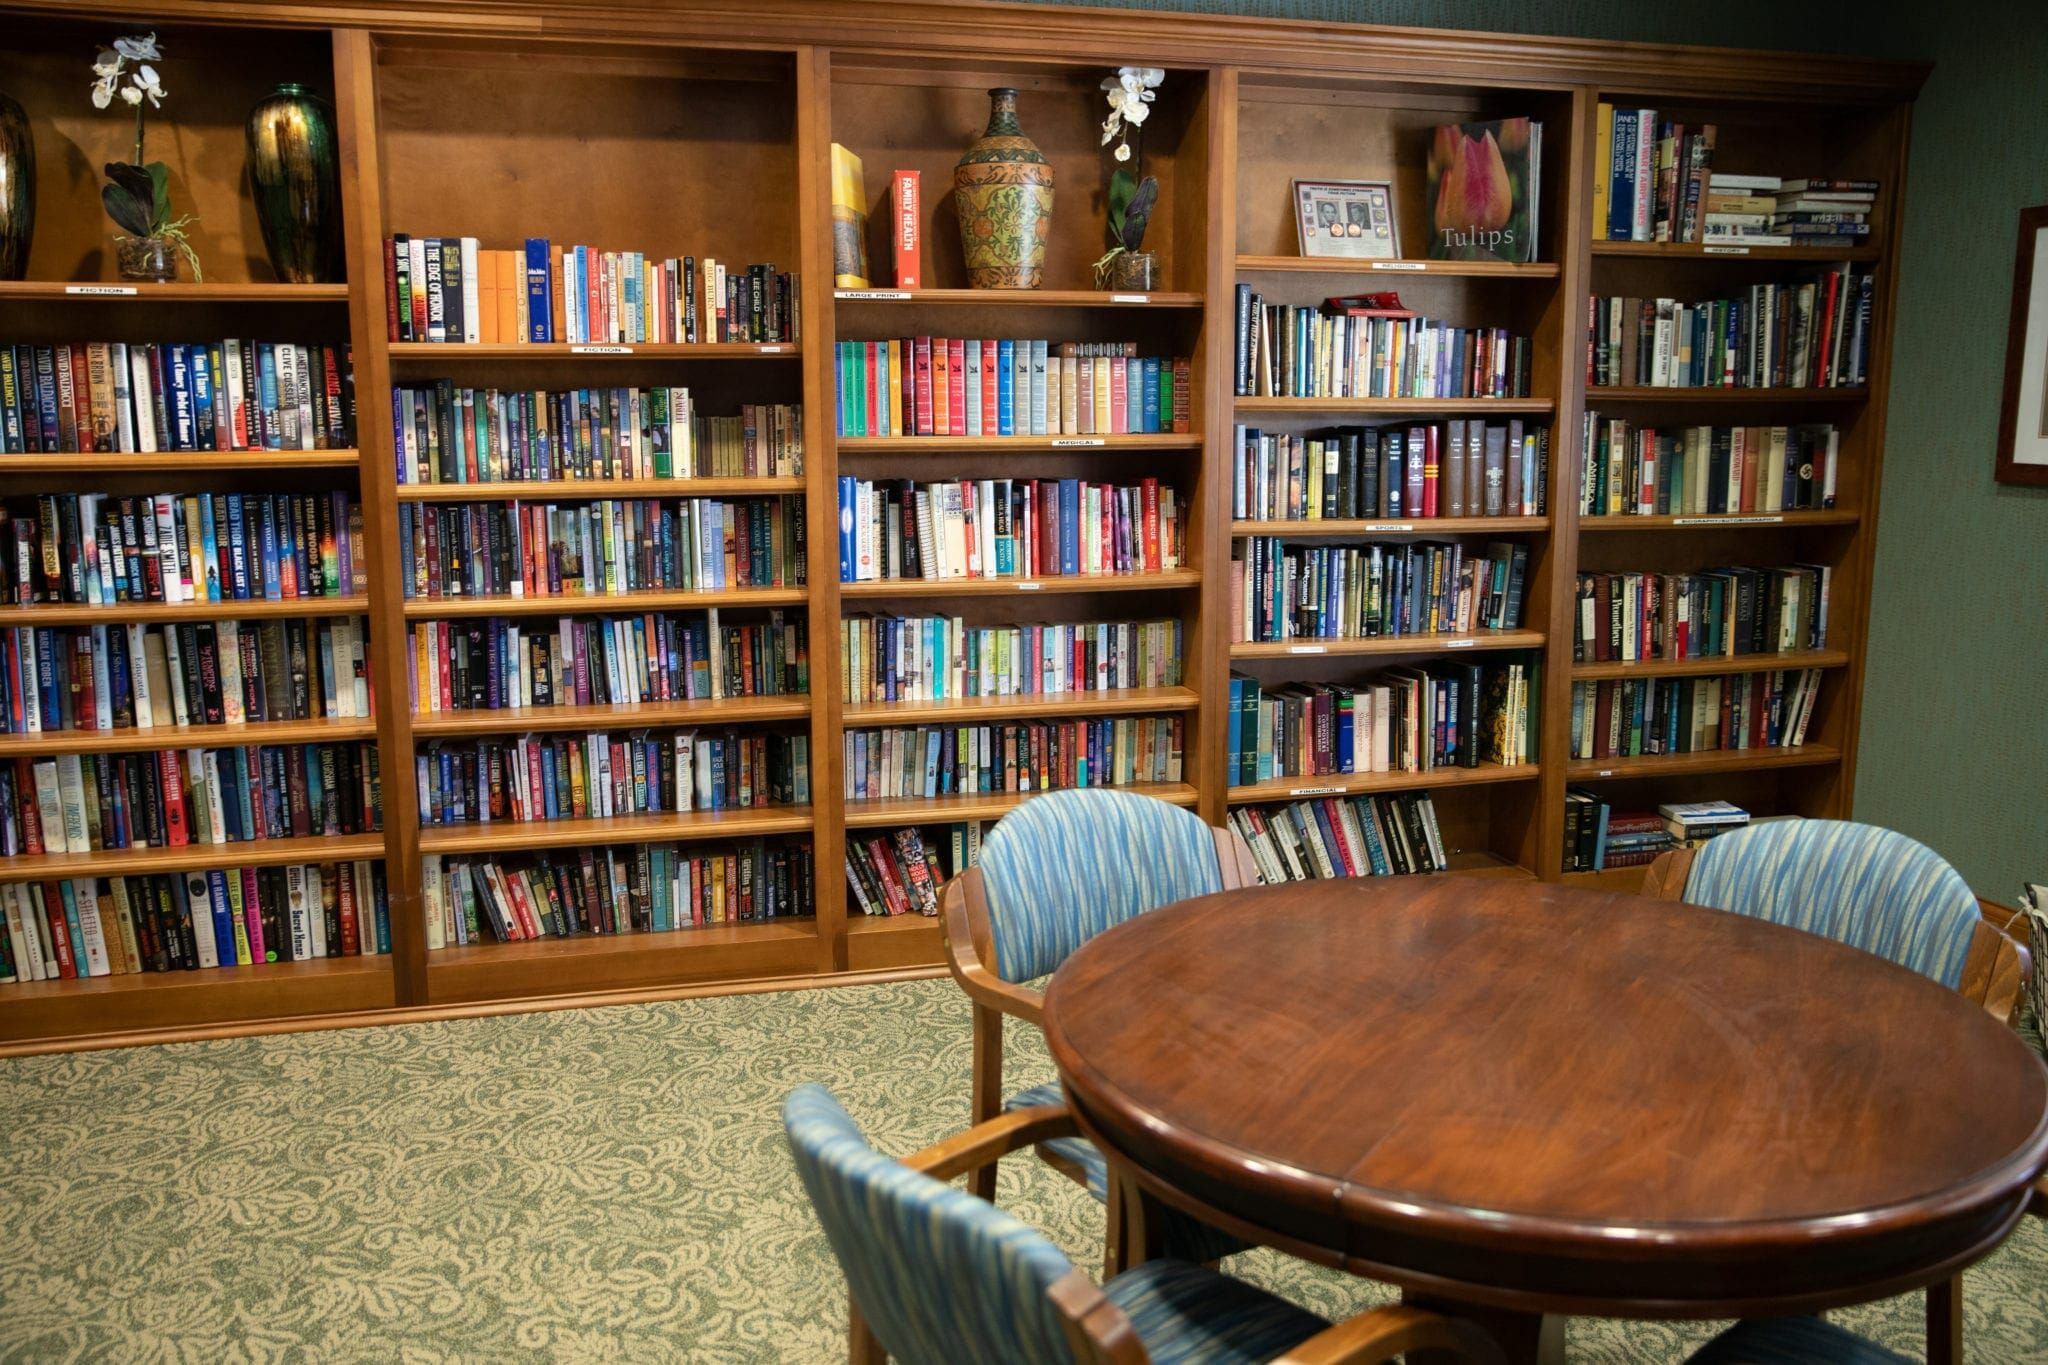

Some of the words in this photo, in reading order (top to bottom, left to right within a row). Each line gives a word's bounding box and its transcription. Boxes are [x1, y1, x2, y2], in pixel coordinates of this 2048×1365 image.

[1642, 113, 1650, 144] WORLD
[1640, 146, 1649, 167] WAR
[903, 178, 912, 210] FAMILY
[1638, 176, 1646, 226] AIRPLANES
[904, 214, 912, 250] HEALTH
[1441, 224, 1514, 250] Tulips
[428, 249, 438, 261] THE
[428, 264, 440, 280] EDGE
[415, 295, 425, 312] CATCH
[430, 293, 442, 321] HONOR
[1, 351, 10, 371] DAVID
[38, 350, 51, 372] DAVID
[58, 349, 68, 368] DAVID
[90, 346, 102, 358] DAN
[173, 346, 184, 360] Tom
[195, 354, 206, 370] Tom
[281, 348, 292, 370] CLIVE
[297, 352, 308, 370] JANET
[92, 361, 105, 384] BROWN
[174, 362, 188, 387] Clancy
[327, 372, 340, 394] KING
[3, 372, 12, 406] BALDACCI
[41, 374, 55, 413] BALDACCI
[60, 369, 72, 407] BALDACCI
[196, 372, 208, 399] Clancy
[284, 373, 295, 406] CUSSLER
[299, 372, 309, 404] EVANOVICH
[244, 398, 252, 435] CRICHTON
[272, 410, 280, 434] SHELTER
[329, 396, 342, 430] REVIVAL
[1732, 446, 1741, 480] WOODWARD
[1588, 461, 1597, 503] AMERICA
[157, 504, 170, 514] NW
[214, 497, 224, 520] BRAD
[229, 496, 240, 520] BRAD
[903, 490, 912, 507] BAD
[263, 502, 272, 527] STUART
[276, 499, 286, 523] STUART
[294, 500, 303, 528] STUART
[305, 498, 317, 530] STUART
[110, 526, 122, 542] JAMES
[123, 516, 136, 544] SANDFORD
[143, 516, 156, 544] SANDFORD
[216, 522, 228, 546] THOR
[231, 522, 242, 546] THOR
[904, 510, 912, 537] BLOOD
[160, 526, 172, 546] ZADIE
[264, 528, 273, 552] WOODS
[280, 525, 288, 549] WOODS
[296, 530, 304, 550] WOODS
[307, 532, 318, 564] WOODS
[113, 544, 126, 576] PATTERSON
[130, 558, 140, 576] SHOCK
[162, 550, 176, 574] SMITH
[234, 548, 243, 570] BLACK
[132, 577, 142, 593] WAVE
[236, 572, 244, 587] LIST
[1612, 599, 1622, 646] Prometheus
[39, 631, 51, 660] HARLAN
[112, 630, 121, 653] Daniel
[42, 662, 52, 686] COBEN
[113, 656, 122, 672] Silva
[134, 657, 146, 698] Educated
[25, 695, 36, 719] MEMORY
[166, 751, 174, 772] MICHAEL
[322, 750, 335, 764] JOHN
[168, 774, 179, 800] CRICHTON
[324, 764, 336, 789] GRISHAM
[27, 826, 36, 844] HEART
[212, 872, 223, 884] IAN
[230, 882, 239, 892] LEE
[290, 868, 302, 890] Griffin
[340, 864, 350, 891] HARLAN
[214, 886, 226, 912] RANKIN
[232, 893, 241, 912] CHILD
[343, 893, 353, 916] COBEN
[80, 900, 96, 934] STILETTO
[292, 911, 304, 932] Secret
[294, 934, 304, 955] Honor
